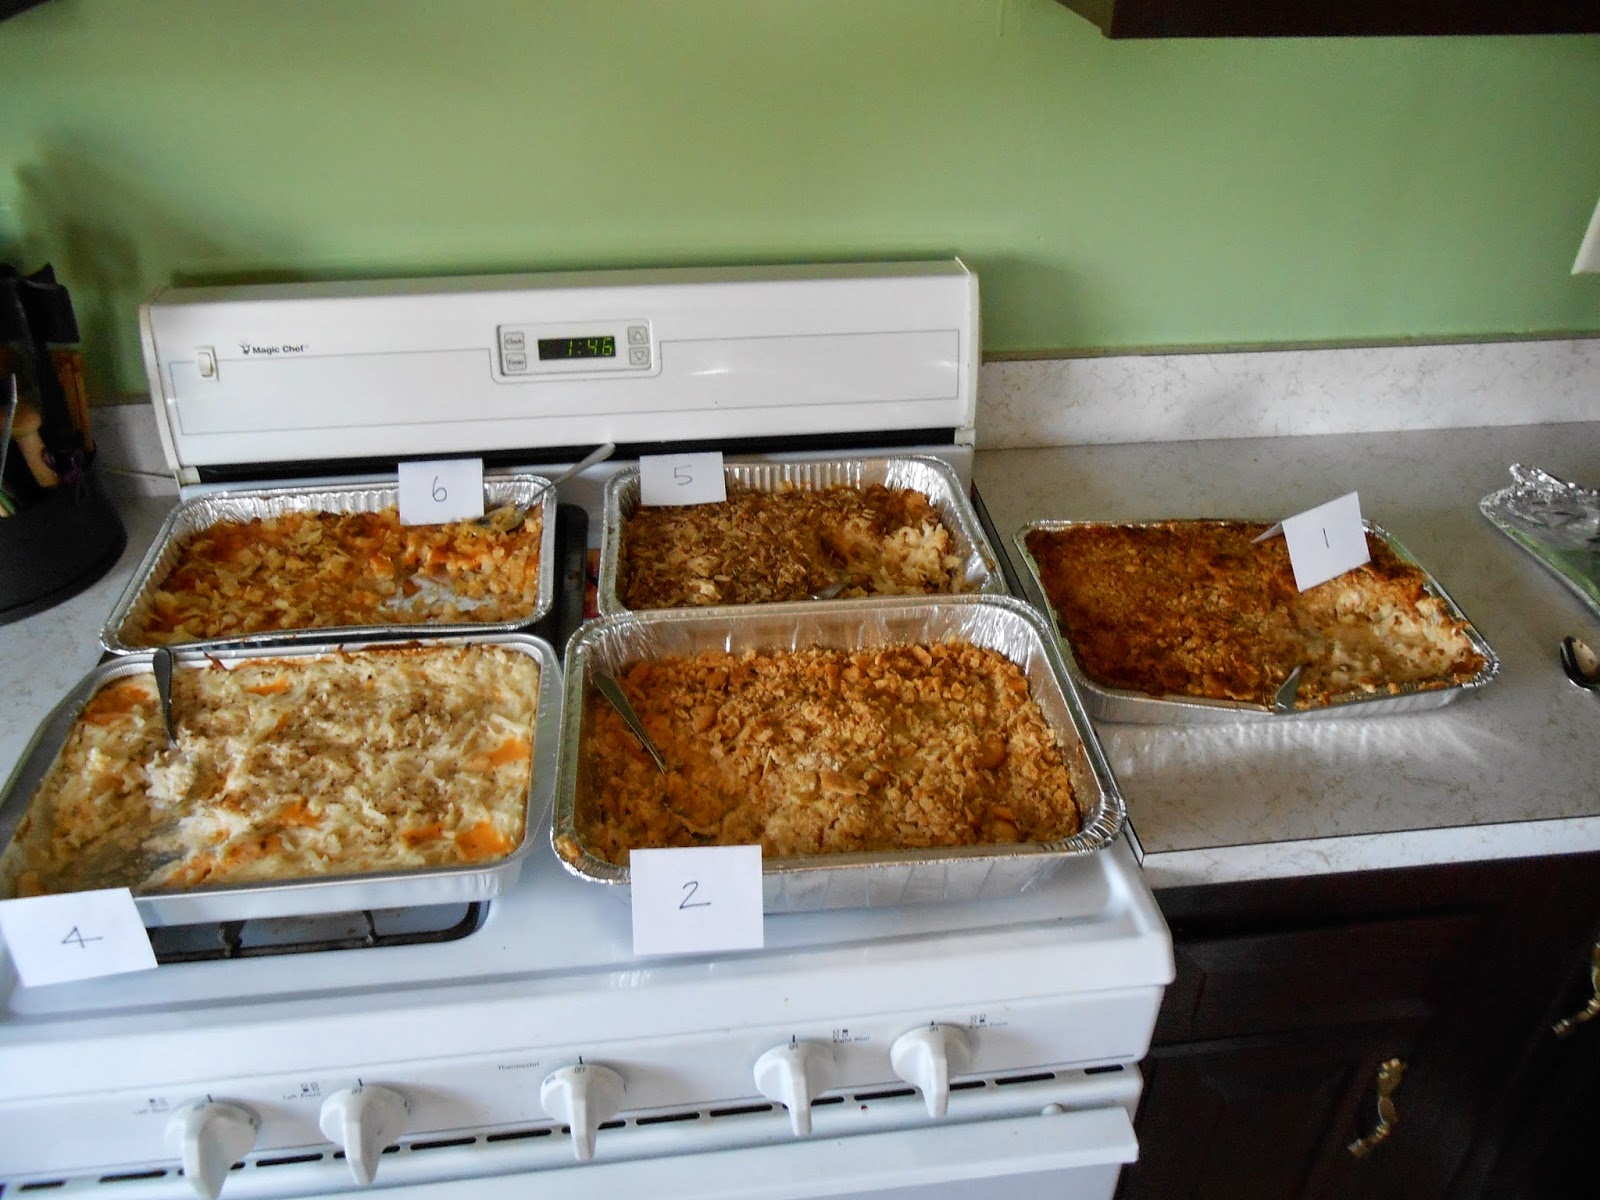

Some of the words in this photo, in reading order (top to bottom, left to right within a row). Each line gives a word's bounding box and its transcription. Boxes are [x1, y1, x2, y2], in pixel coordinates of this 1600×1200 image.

[252, 346, 280, 355] Magic
[282, 344, 304, 353] Chef
[568, 337, 613, 356] 1:46
[673, 465, 693, 487] 5
[432, 475, 448, 503] 6
[1322, 527, 1330, 549] 1
[679, 881, 711, 909] 2
[61, 925, 104, 949] 4
